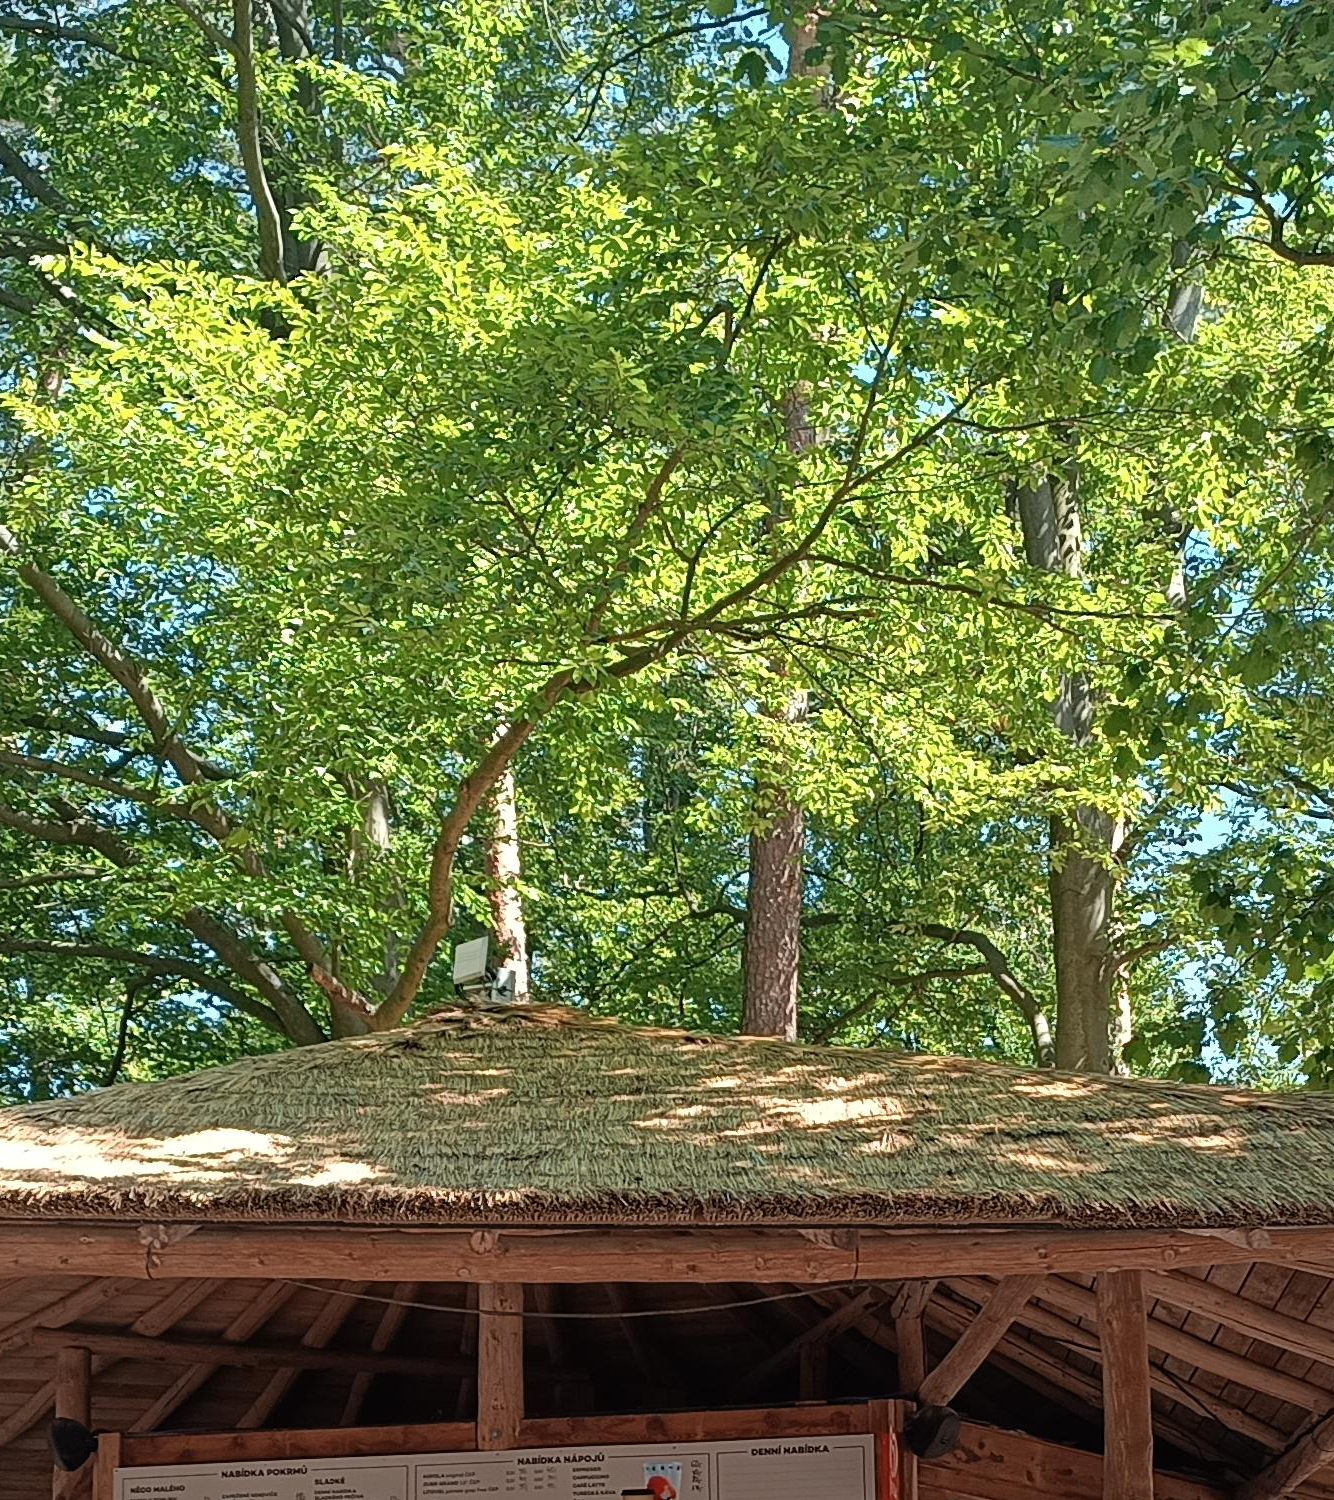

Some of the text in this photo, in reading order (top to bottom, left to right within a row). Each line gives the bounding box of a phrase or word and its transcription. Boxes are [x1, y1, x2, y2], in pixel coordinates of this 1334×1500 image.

[751, 1443, 829, 1456] DENNÍ NABÍDKA
[517, 1452, 605, 1465] NABÍDKA NÁPOJŮ
[221, 1465, 308, 1478] NABÍDKA POKRMŮ
[315, 1476, 345, 1485] SLADKÉ
[153, 1484, 185, 1492] MALÉHO
